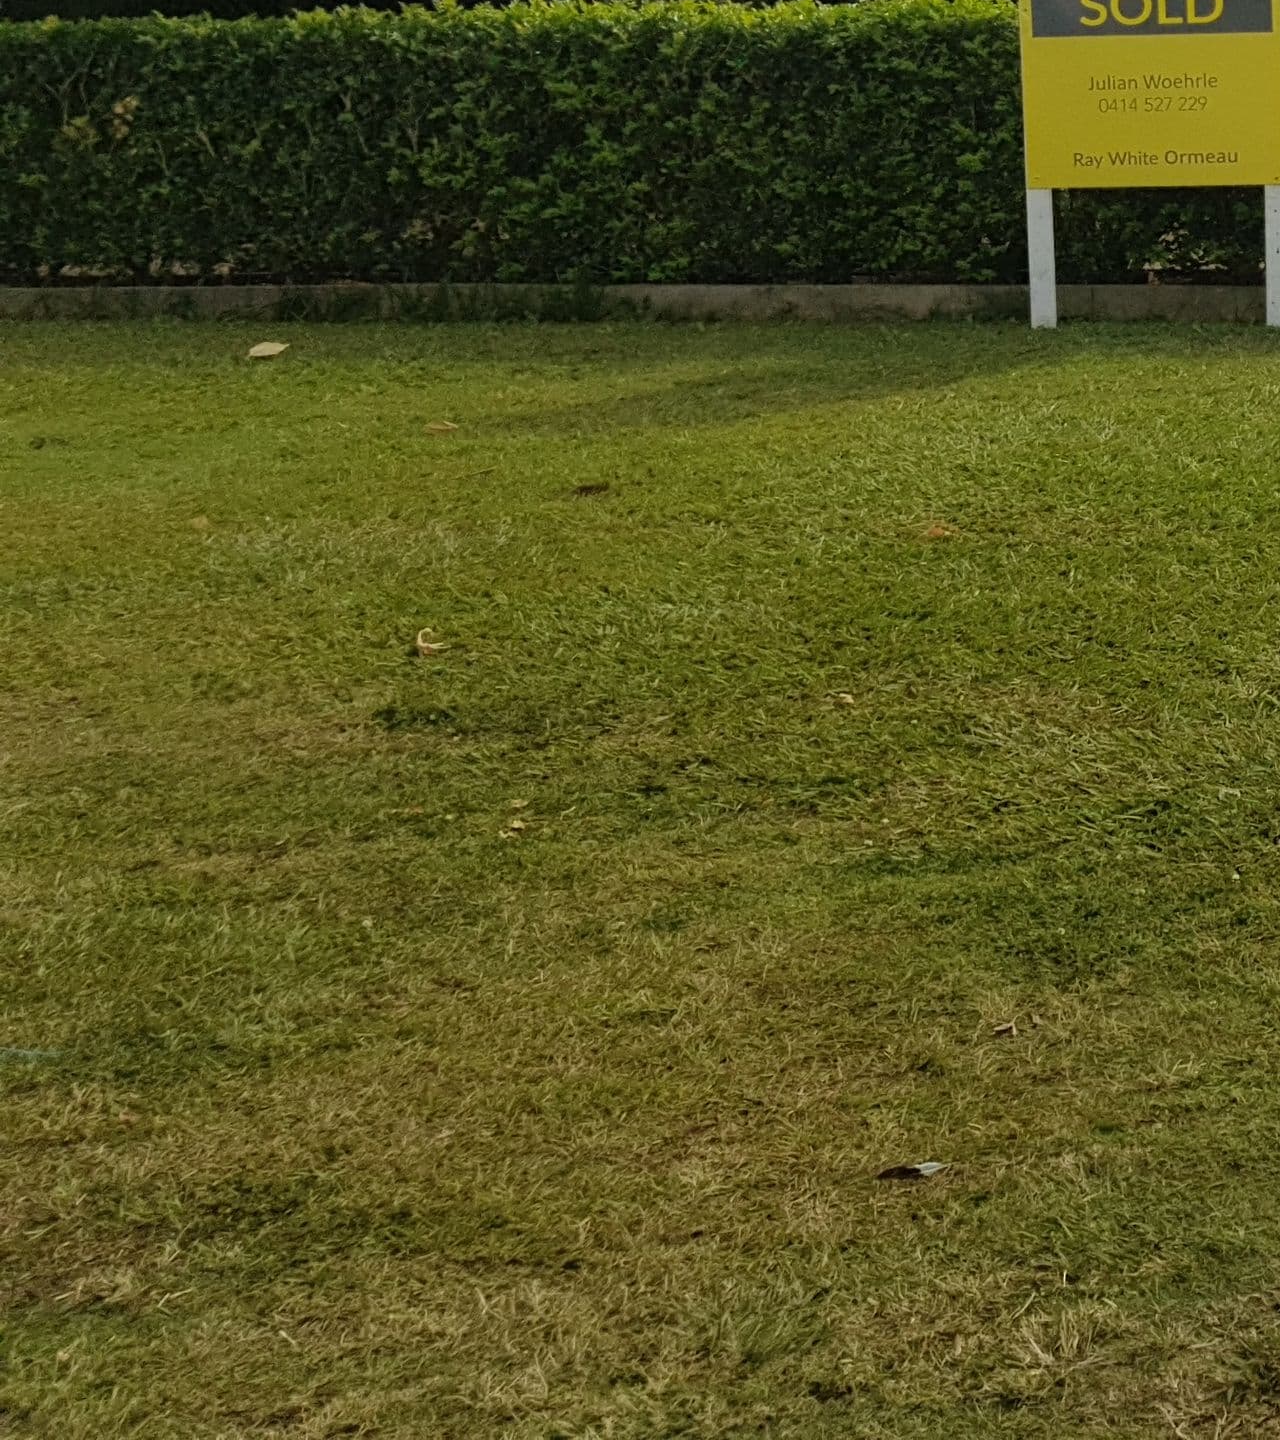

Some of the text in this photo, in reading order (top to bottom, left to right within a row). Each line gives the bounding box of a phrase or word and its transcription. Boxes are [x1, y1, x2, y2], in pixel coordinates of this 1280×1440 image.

[1088, 72, 1218, 91] Julian Woehrle
[1098, 95, 1208, 113] 0414 527 229
[1073, 150, 1238, 169] Ray White Ormeau
